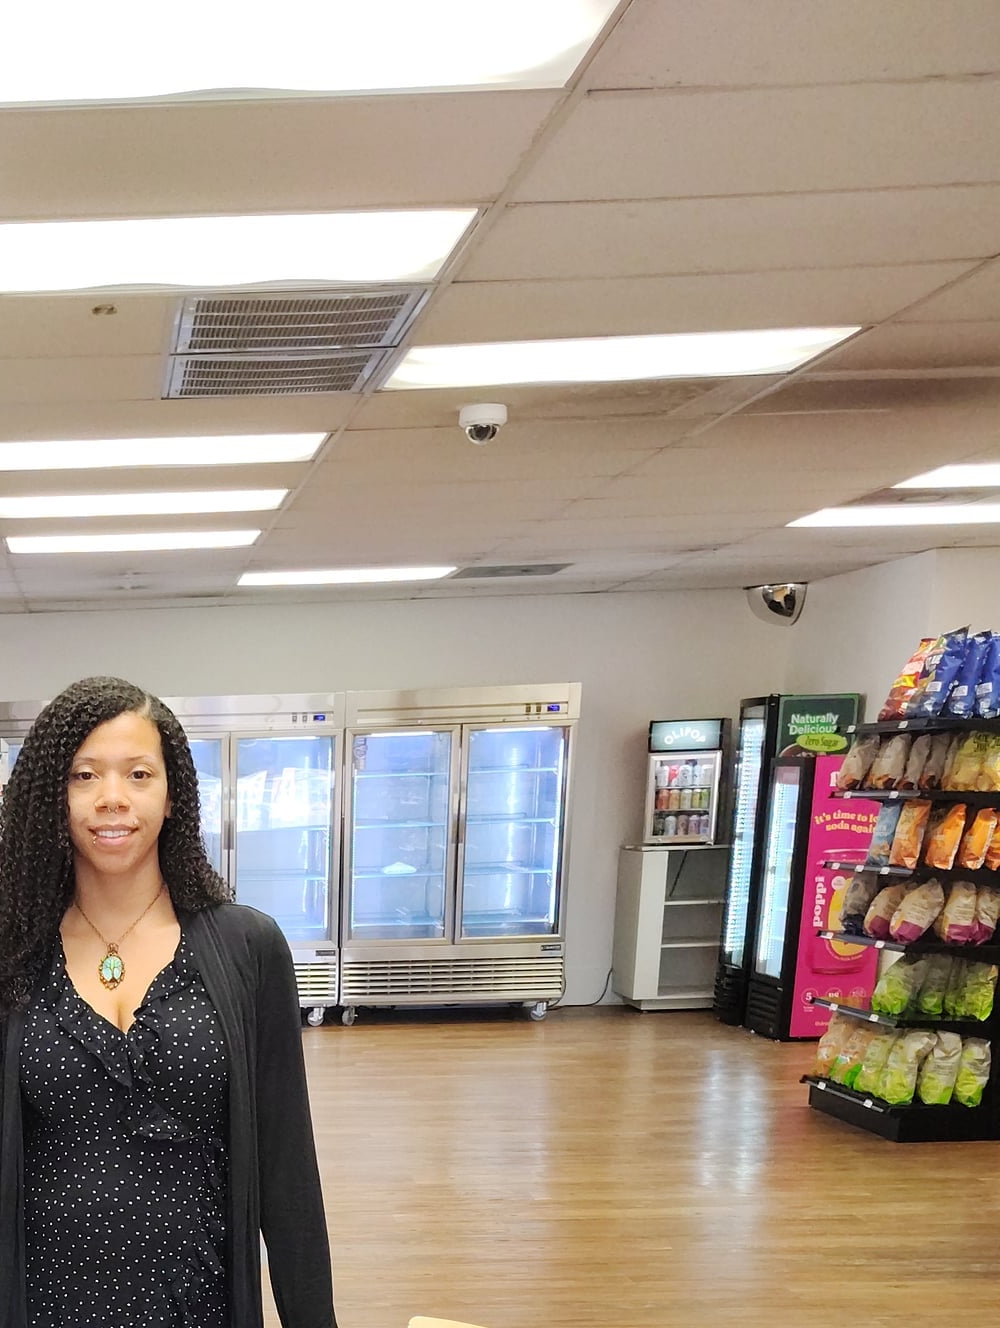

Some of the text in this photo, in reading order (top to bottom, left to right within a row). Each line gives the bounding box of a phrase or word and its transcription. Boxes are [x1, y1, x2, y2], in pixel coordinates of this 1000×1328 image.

[791, 712, 839, 724] Naturally
[664, 727, 706, 744] OLIPOP
[788, 724, 837, 735] Delicious
[833, 809, 856, 820] time
[857, 814, 868, 823] to
[825, 820, 876, 834] soda agai
[813, 876, 827, 928] poppi
